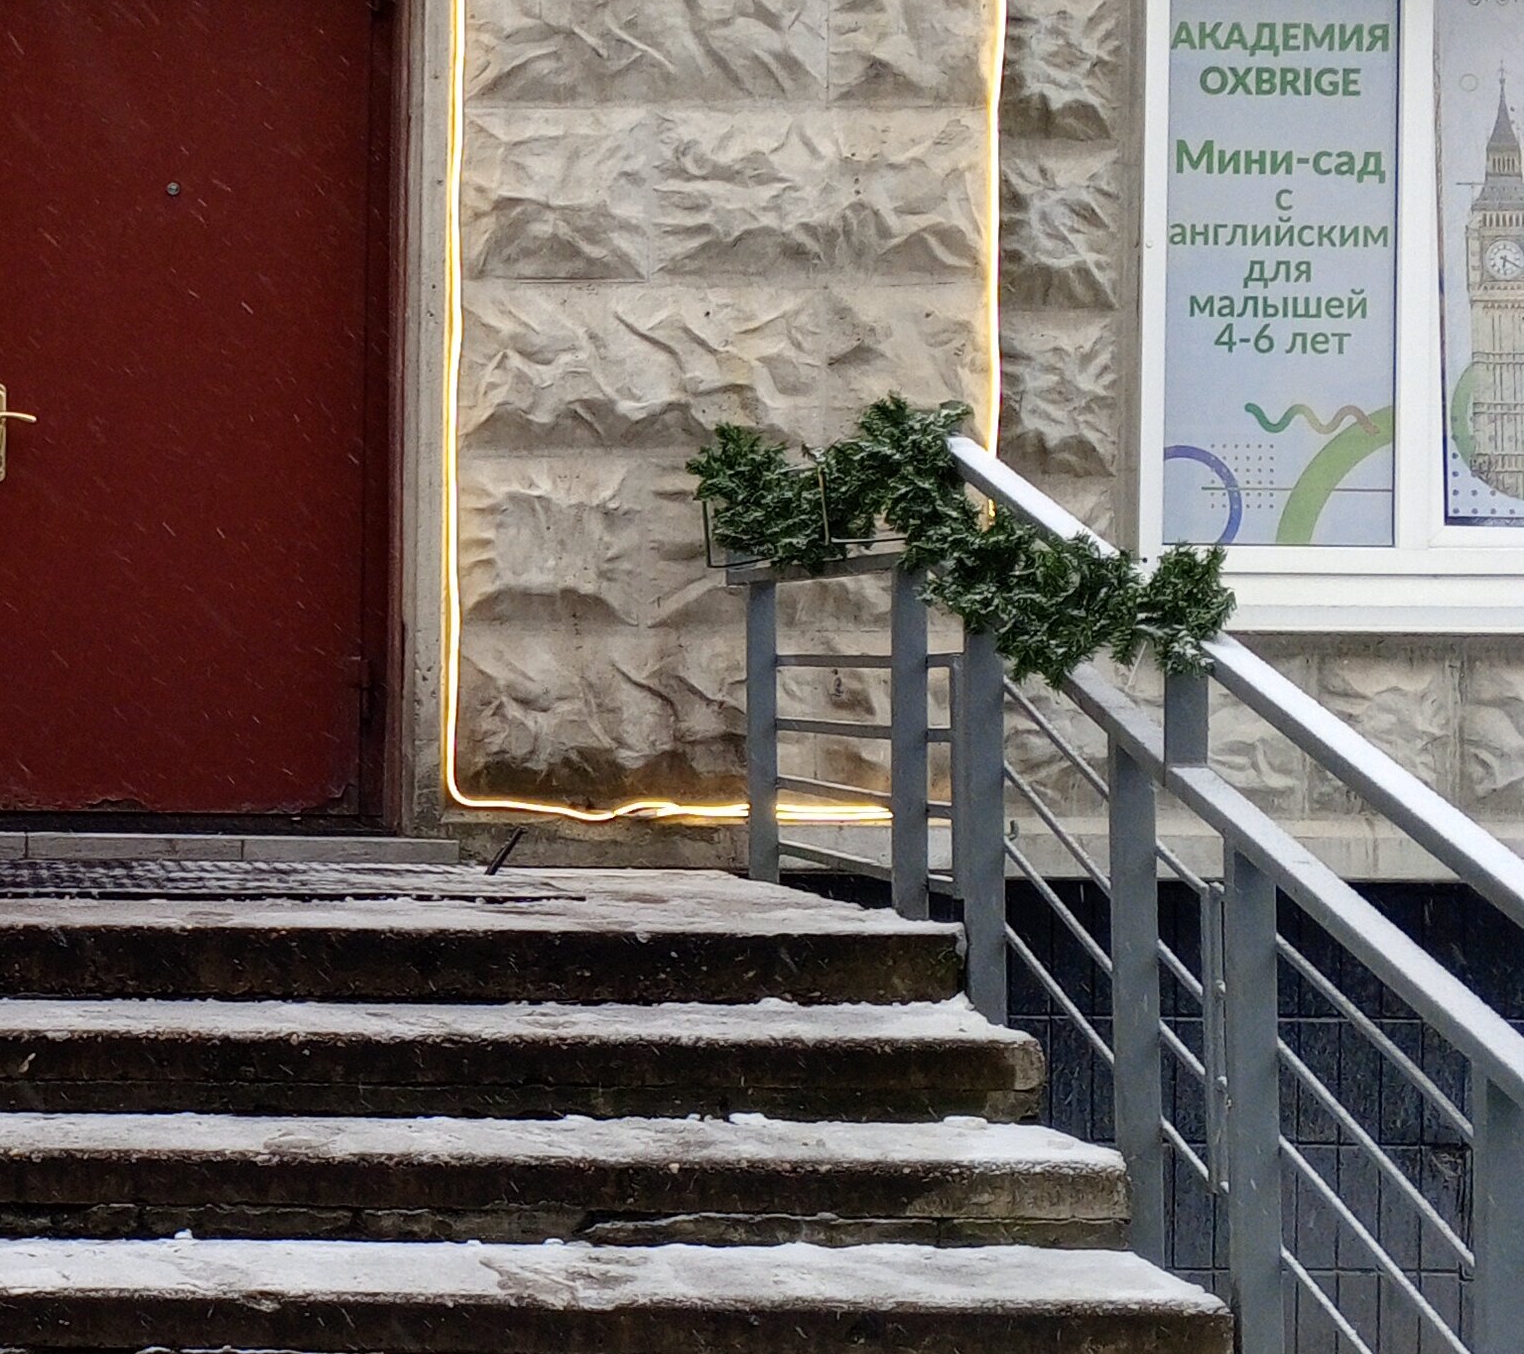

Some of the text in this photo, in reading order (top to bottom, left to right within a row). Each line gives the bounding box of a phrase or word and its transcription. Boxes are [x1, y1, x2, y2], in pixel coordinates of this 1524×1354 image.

[1170, 21, 1390, 57] АКАДЕМИЯ
[1199, 66, 1361, 96] OXBRIGE
[1176, 139, 1386, 184] Мини-сад
[1275, 188, 1293, 211] с
[1168, 216, 1389, 248] английским
[1242, 260, 1312, 289] для
[1189, 288, 1368, 319] малышей
[1214, 323, 1352, 354] 4-6 лет
